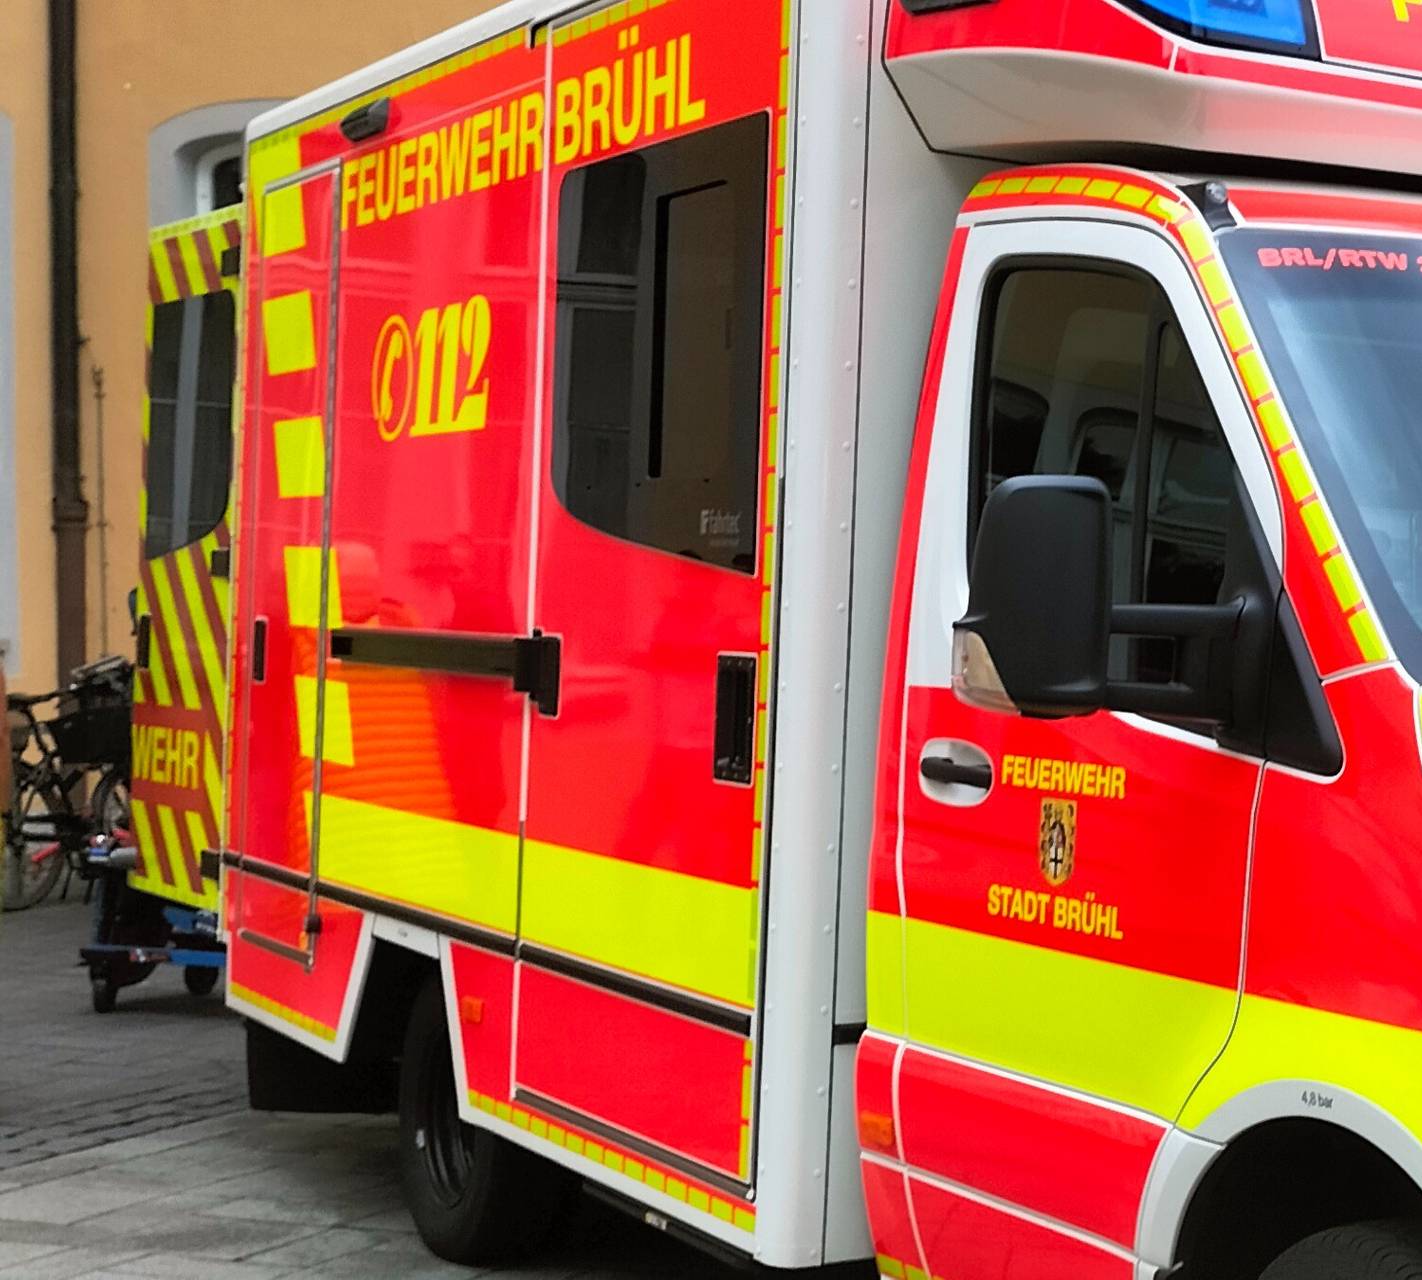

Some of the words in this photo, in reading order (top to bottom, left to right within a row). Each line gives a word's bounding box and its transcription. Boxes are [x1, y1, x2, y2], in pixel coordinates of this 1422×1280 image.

[340, 92, 545, 231] FEUERWEHR
[555, 24, 705, 165] BRÜHL
[1257, 247, 1409, 271] BRL/RTW
[409, 294, 491, 437] 112
[132, 724, 199, 790] WEHR
[1001, 754, 1127, 800] FEUERWEHR
[987, 884, 1051, 925] STADT
[1053, 891, 1124, 940] BRÜHL
[1318, 1093, 1333, 1108] bar
